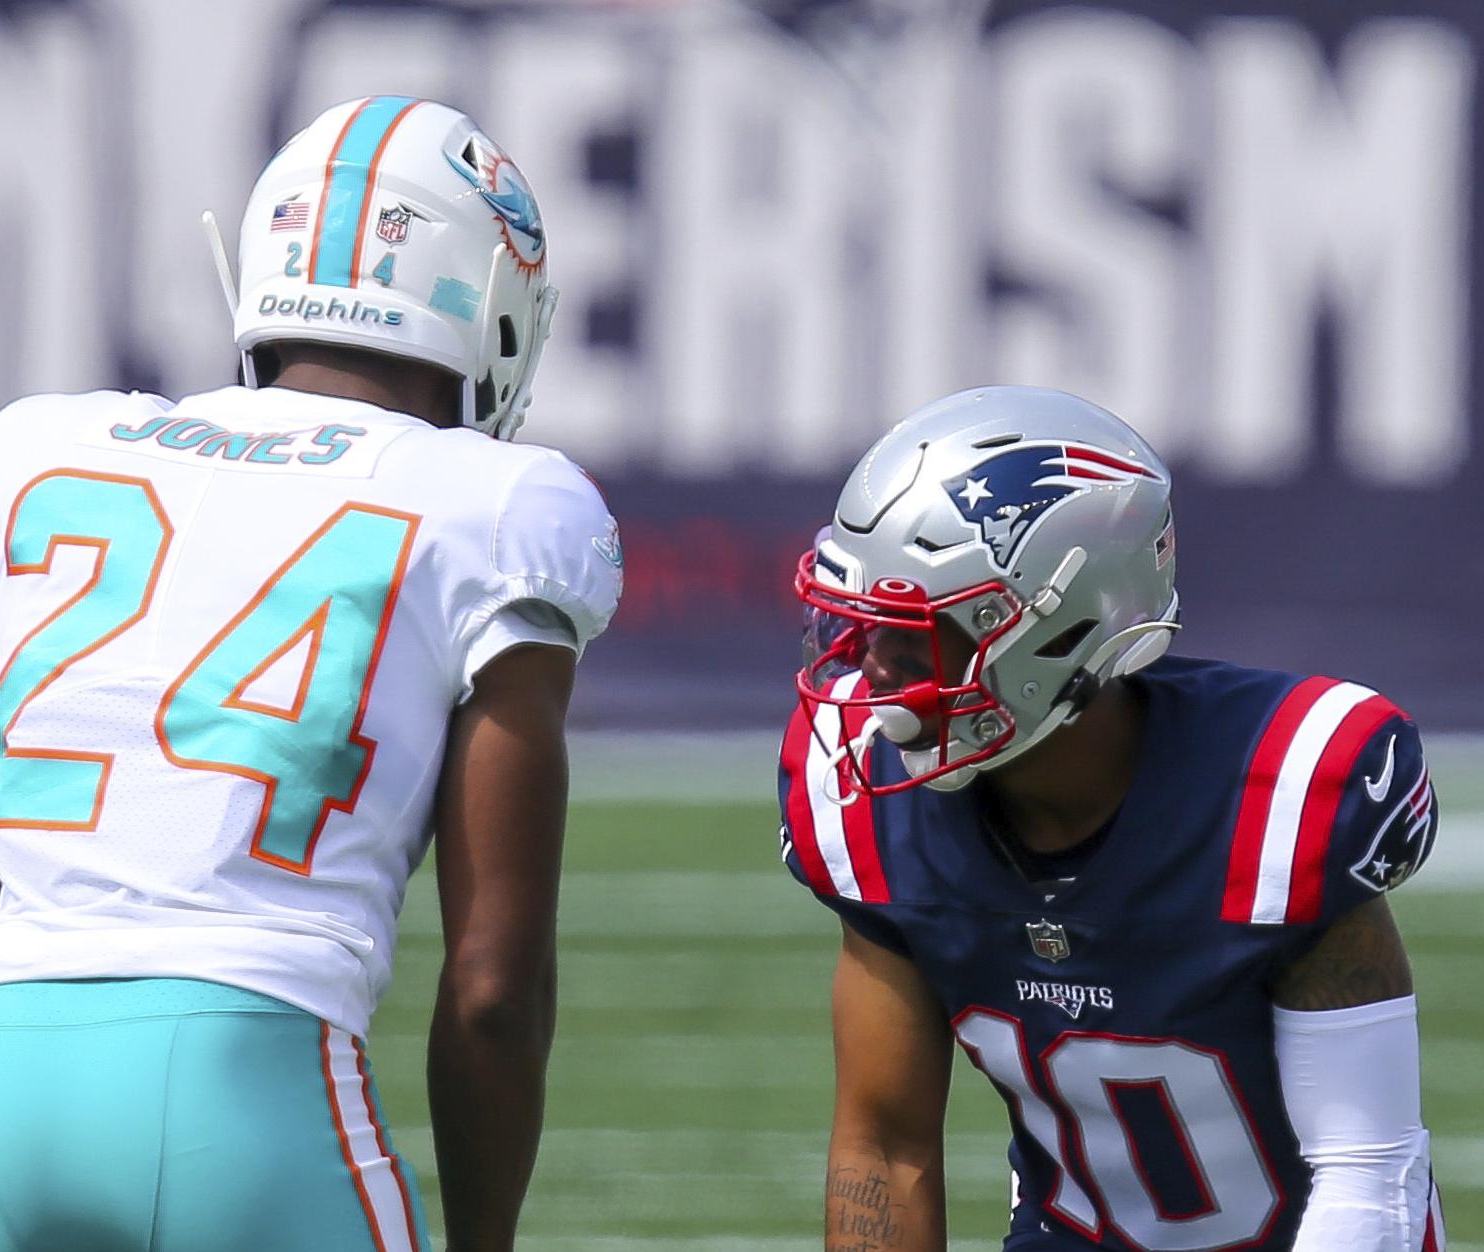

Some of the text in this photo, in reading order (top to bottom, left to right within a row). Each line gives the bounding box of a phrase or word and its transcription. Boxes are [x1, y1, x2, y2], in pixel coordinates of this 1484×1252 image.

[284, 241, 396, 287] 2 4
[258, 294, 405, 327] Dolphins
[110, 416, 367, 465] JONES
[1016, 980, 1114, 1009] PATRIOTS
